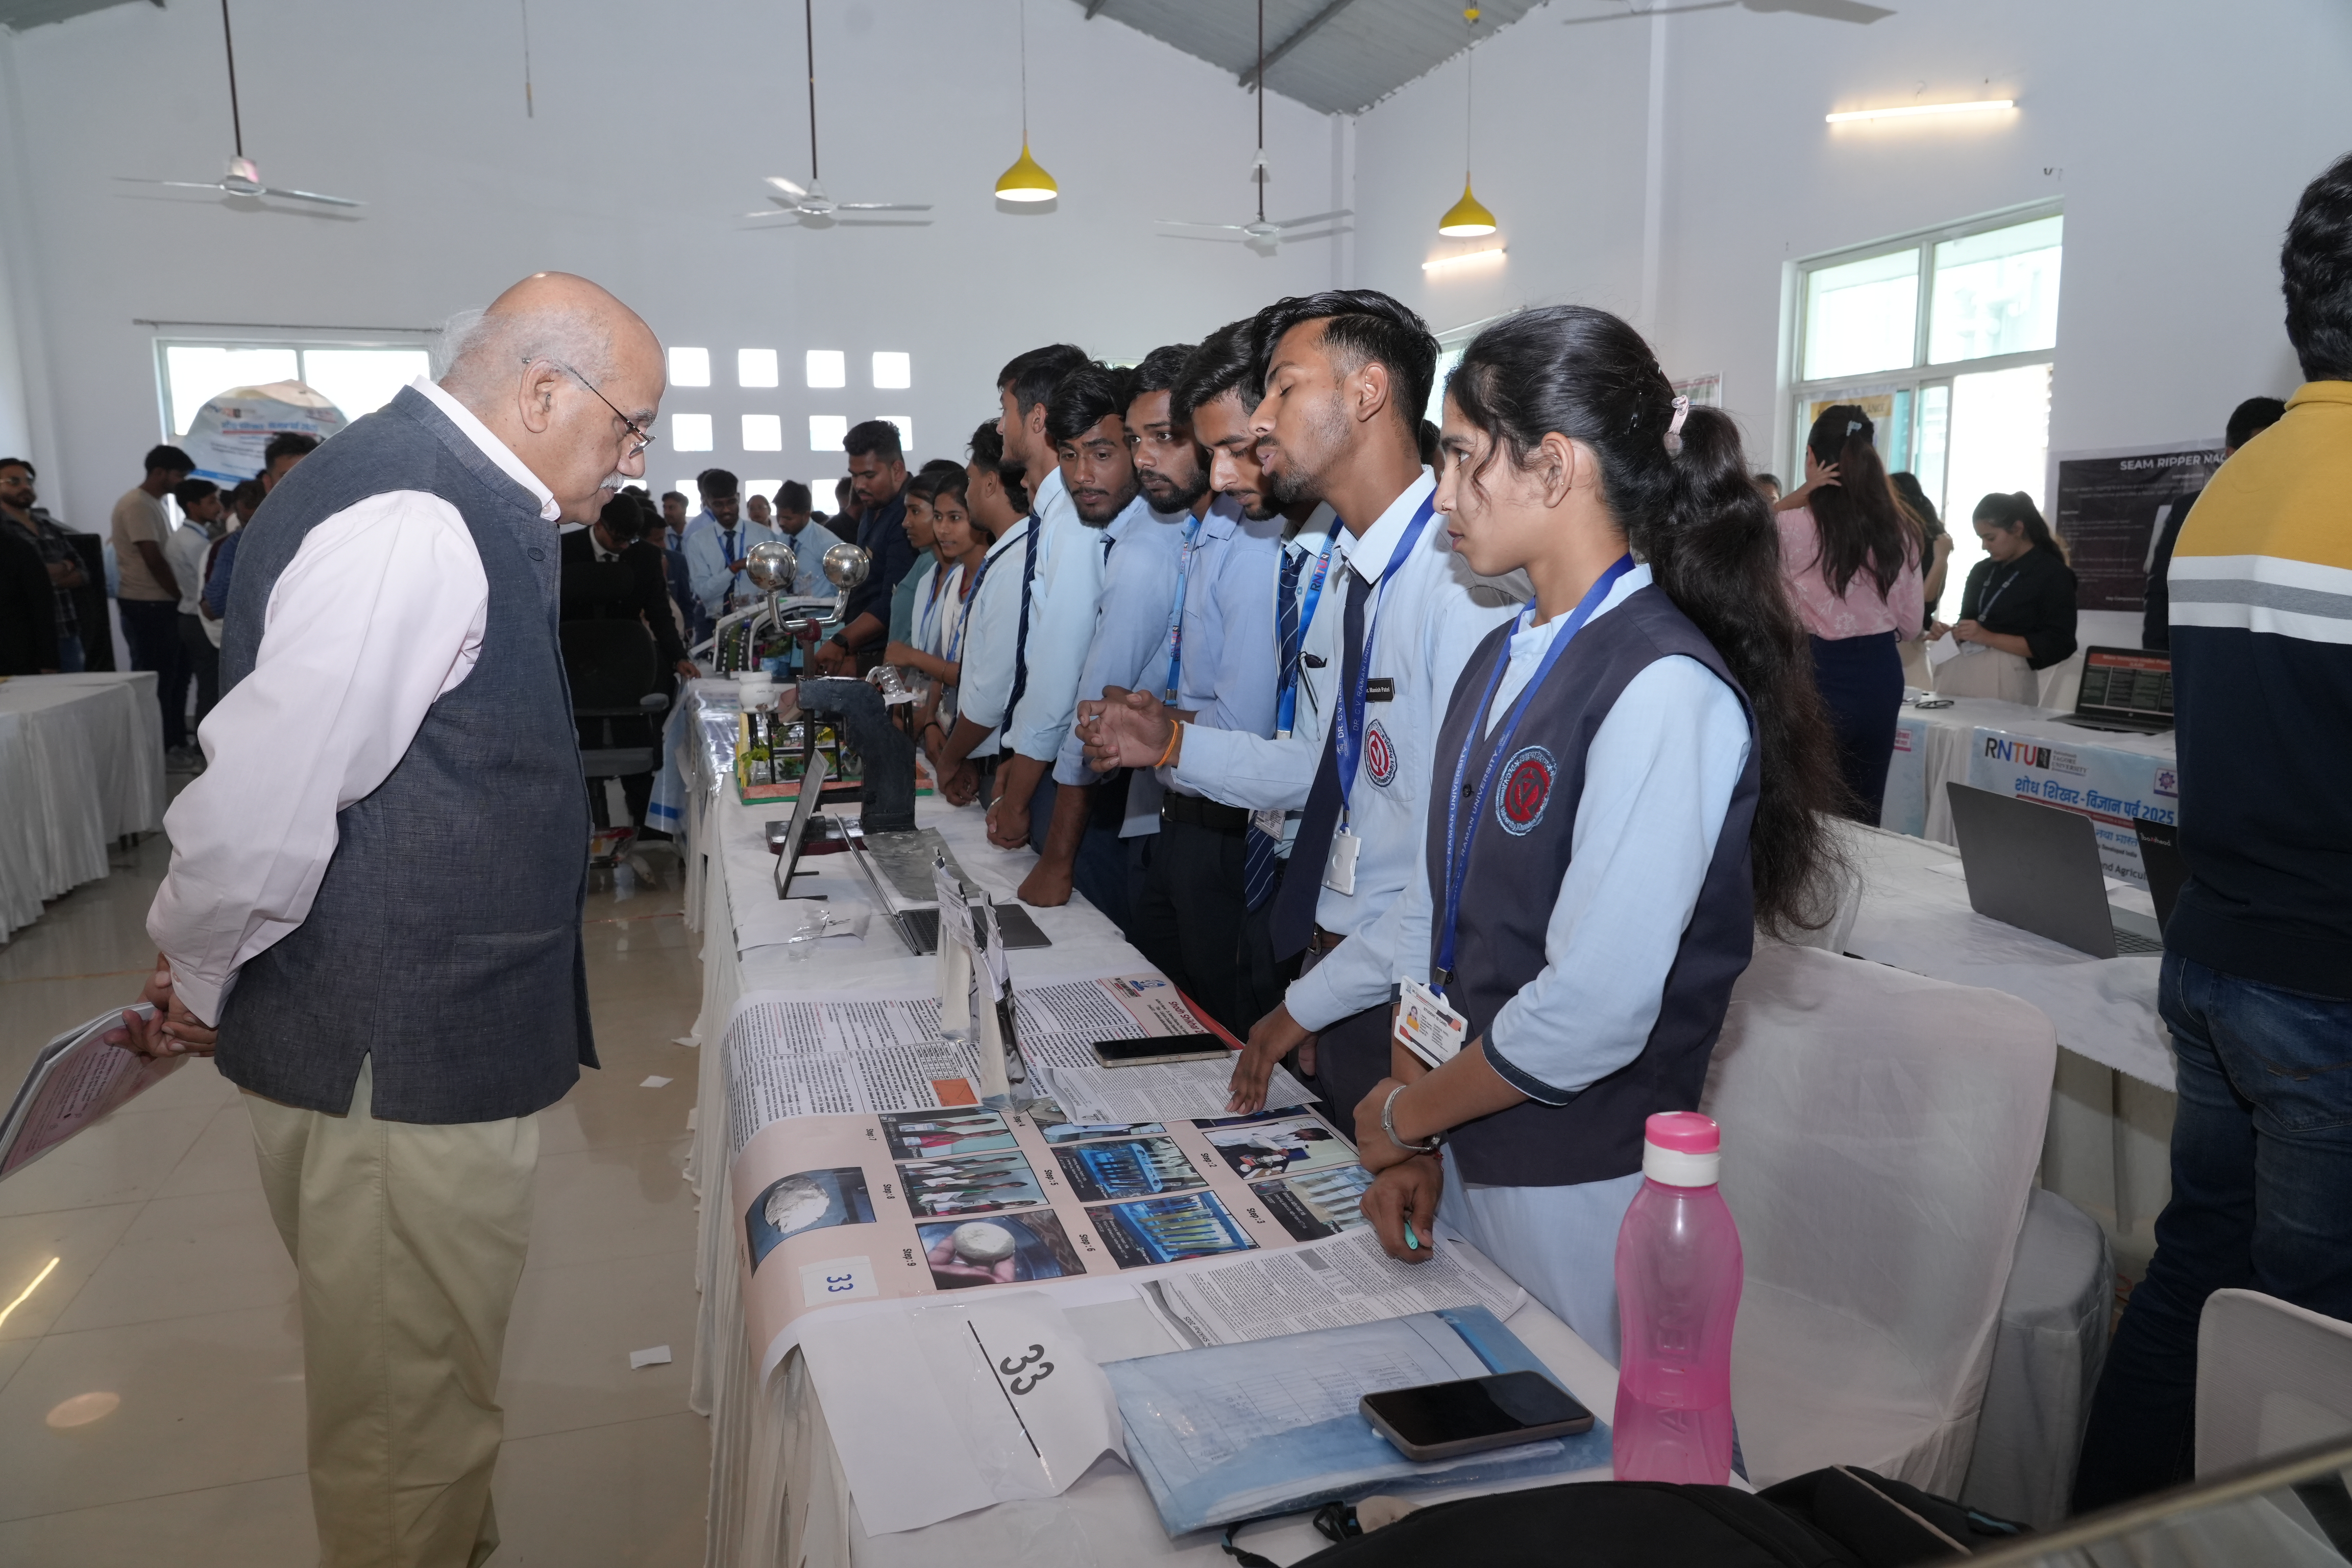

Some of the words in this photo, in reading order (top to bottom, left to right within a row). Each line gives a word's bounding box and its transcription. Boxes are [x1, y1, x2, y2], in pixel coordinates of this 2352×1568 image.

[2120, 459, 2154, 471] SEAM
[2158, 456, 2201, 468] RIPPER
[2203, 454, 2226, 464] MAC
[1180, 549, 1188, 574] RNTU
[1310, 559, 1327, 592] RNTU
[1170, 632, 1179, 657] RNTU
[1356, 666, 1366, 697] RAMAN
[1985, 737, 2037, 766] RNTU
[2052, 762, 2089, 774] UNIVERSITY
[1451, 746, 1467, 811] UNIVERSITY
[1461, 816, 1474, 857] RAMAN
[1473, 749, 1499, 814] UNIVERSITY
[2015, 776, 2040, 795] शोध
[2043, 780, 2080, 804] शिखर
[2086, 790, 2122, 815] विज्ञान
[2124, 800, 2141, 817] पर्व
[2142, 805, 2174, 825] 2025
[2102, 863, 2113, 871] nd
[2115, 865, 2146, 880] Agricul
[1168, 1001, 1186, 1014] Shodh
[1180, 1015, 1200, 1030] Shikhar
[1424, 1007, 1436, 1018] STUDENT
[1439, 1019, 1448, 1027] CARD
[1200, 1152, 1213, 1161] Step
[1044, 1169, 1054, 1180] Step
[883, 1184, 893, 1193] Step
[1247, 1208, 1259, 1218] Step
[1079, 1234, 1090, 1244] Step
[903, 1248, 913, 1259] Step
[826, 1273, 854, 1292] 33
[1184, 1316, 1196, 1325] 2025
[1193, 1326, 1210, 1342] Shikhar
[999, 1344, 1055, 1395] 33
